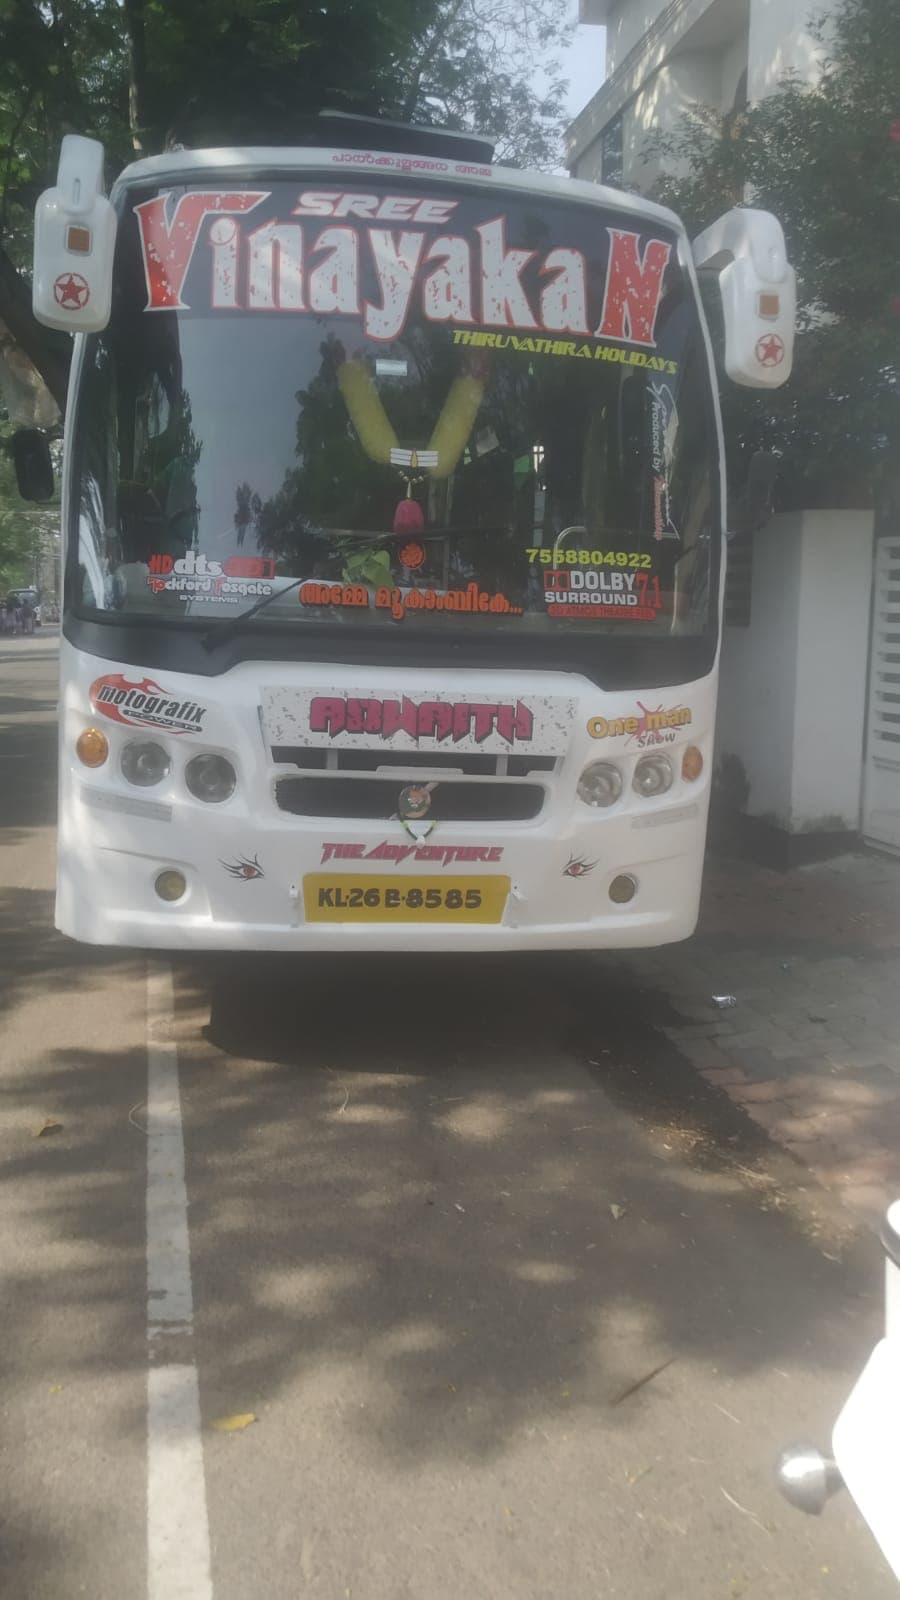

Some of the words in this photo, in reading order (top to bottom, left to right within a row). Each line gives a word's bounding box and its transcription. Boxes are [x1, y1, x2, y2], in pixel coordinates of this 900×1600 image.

[292, 191, 459, 224] SREE
[452, 330, 592, 359] THIRUVATHIRA
[594, 345, 678, 376] HOLIDAYS
[174, 550, 223, 576] dts
[569, 570, 636, 591] DOLBY
[544, 591, 638, 606] SURROUND
[97, 685, 207, 723] motografix
[586, 716, 639, 740] One
